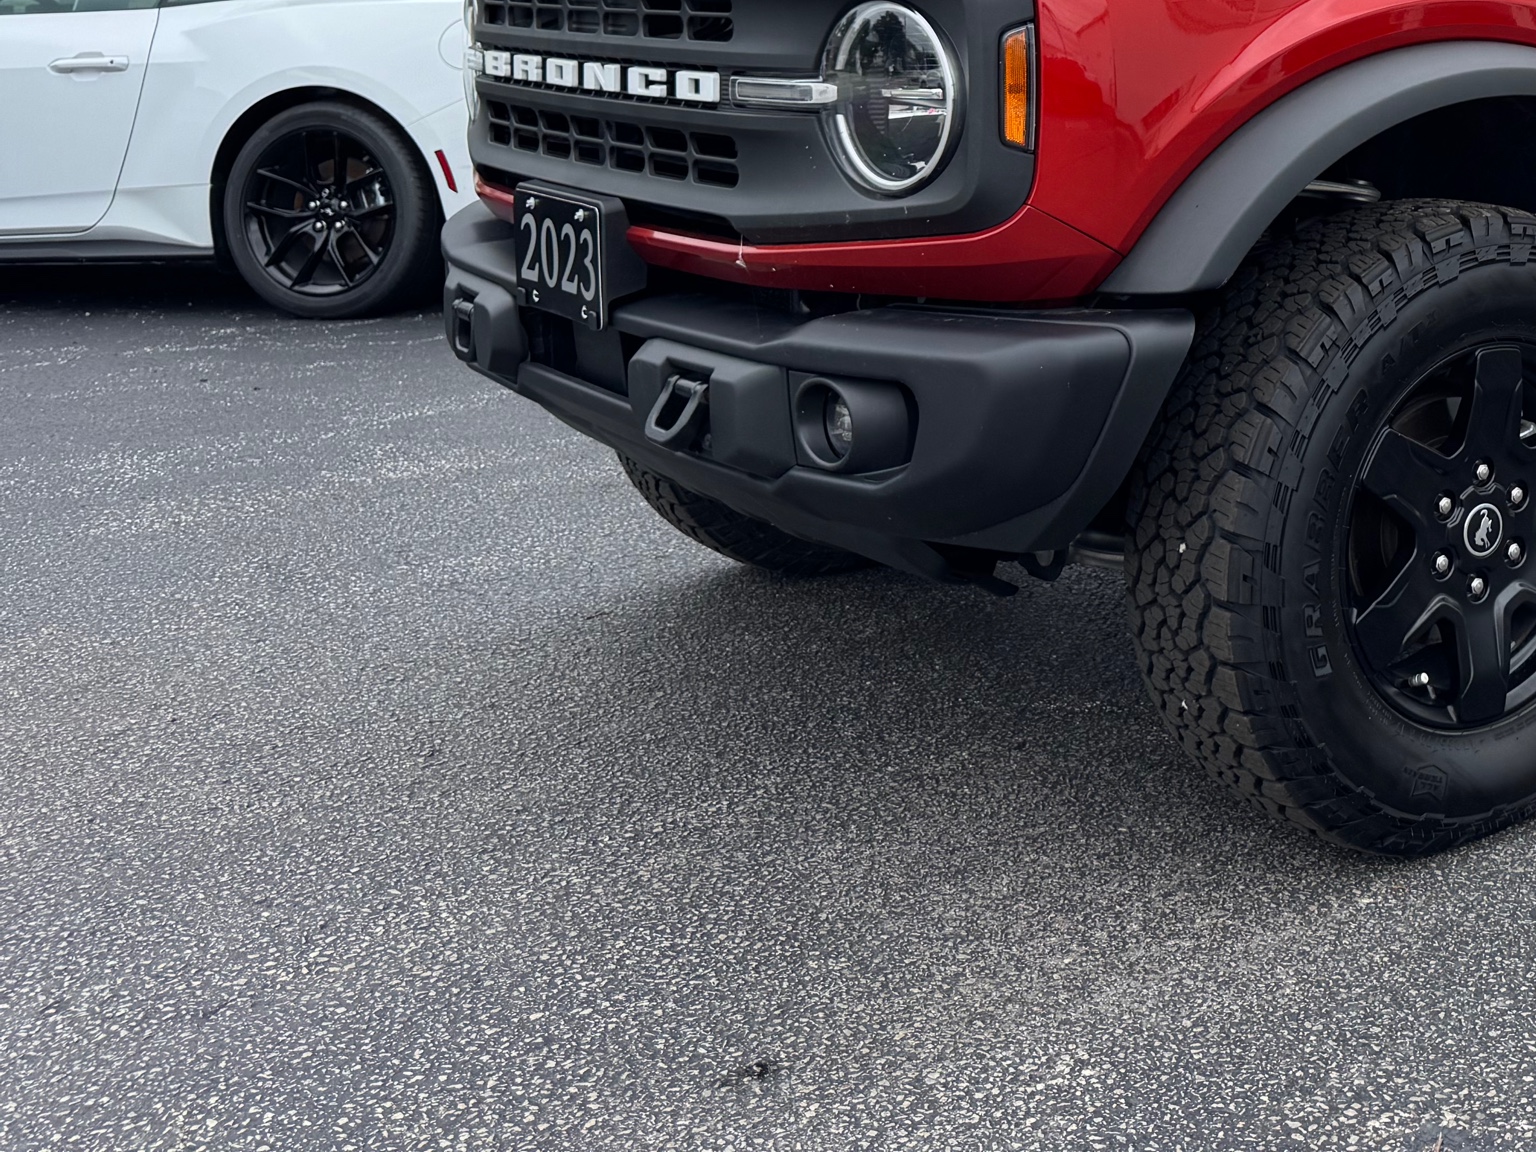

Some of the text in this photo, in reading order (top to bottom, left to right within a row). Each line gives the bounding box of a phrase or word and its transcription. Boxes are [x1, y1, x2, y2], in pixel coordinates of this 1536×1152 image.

[484, 50, 721, 103] BRONCO
[520, 213, 596, 302] 2023
[1302, 387, 1369, 679] GRABBER
